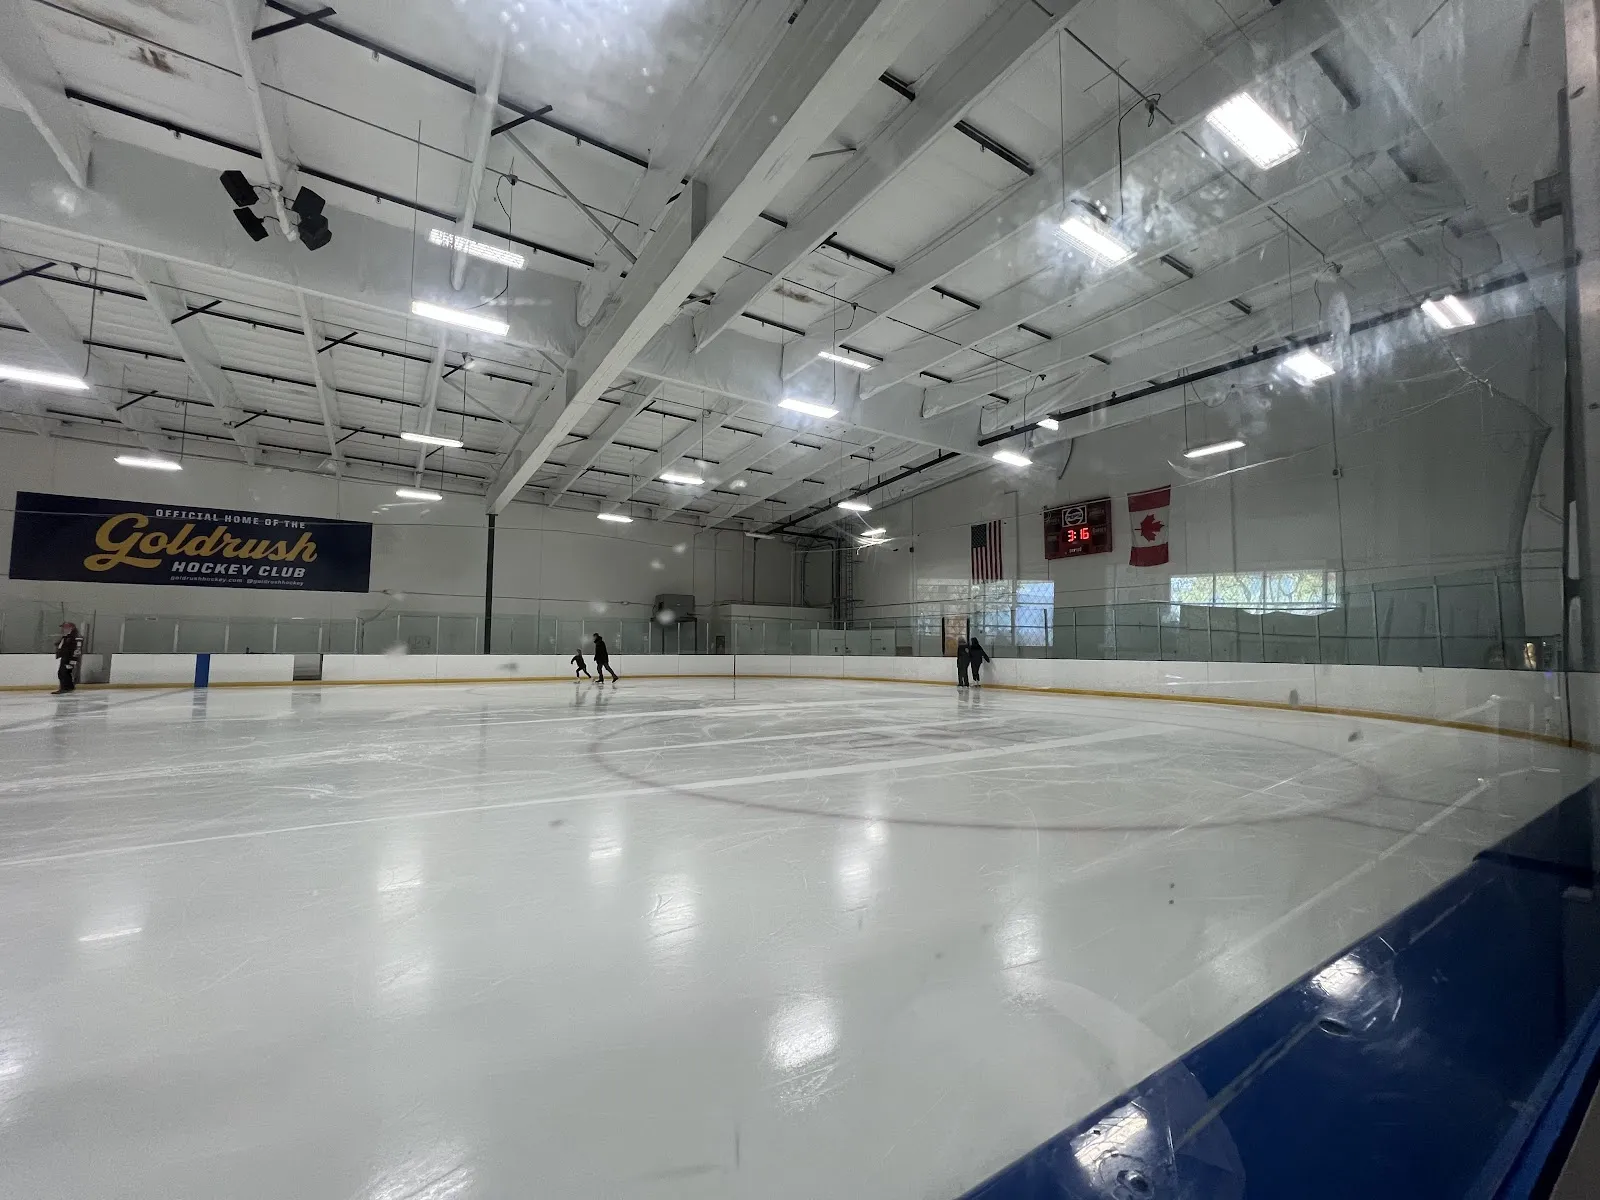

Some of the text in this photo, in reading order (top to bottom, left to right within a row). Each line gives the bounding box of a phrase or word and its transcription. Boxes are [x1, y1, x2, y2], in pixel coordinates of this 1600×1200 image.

[156, 509, 306, 529] OFFICIAL HOME OF THE
[83, 512, 318, 572] Goldrush
[1067, 527, 1089, 542] 3:16
[171, 561, 306, 578] HOCKEY CLUB
[170, 575, 243, 583] goldrushhockey.com
